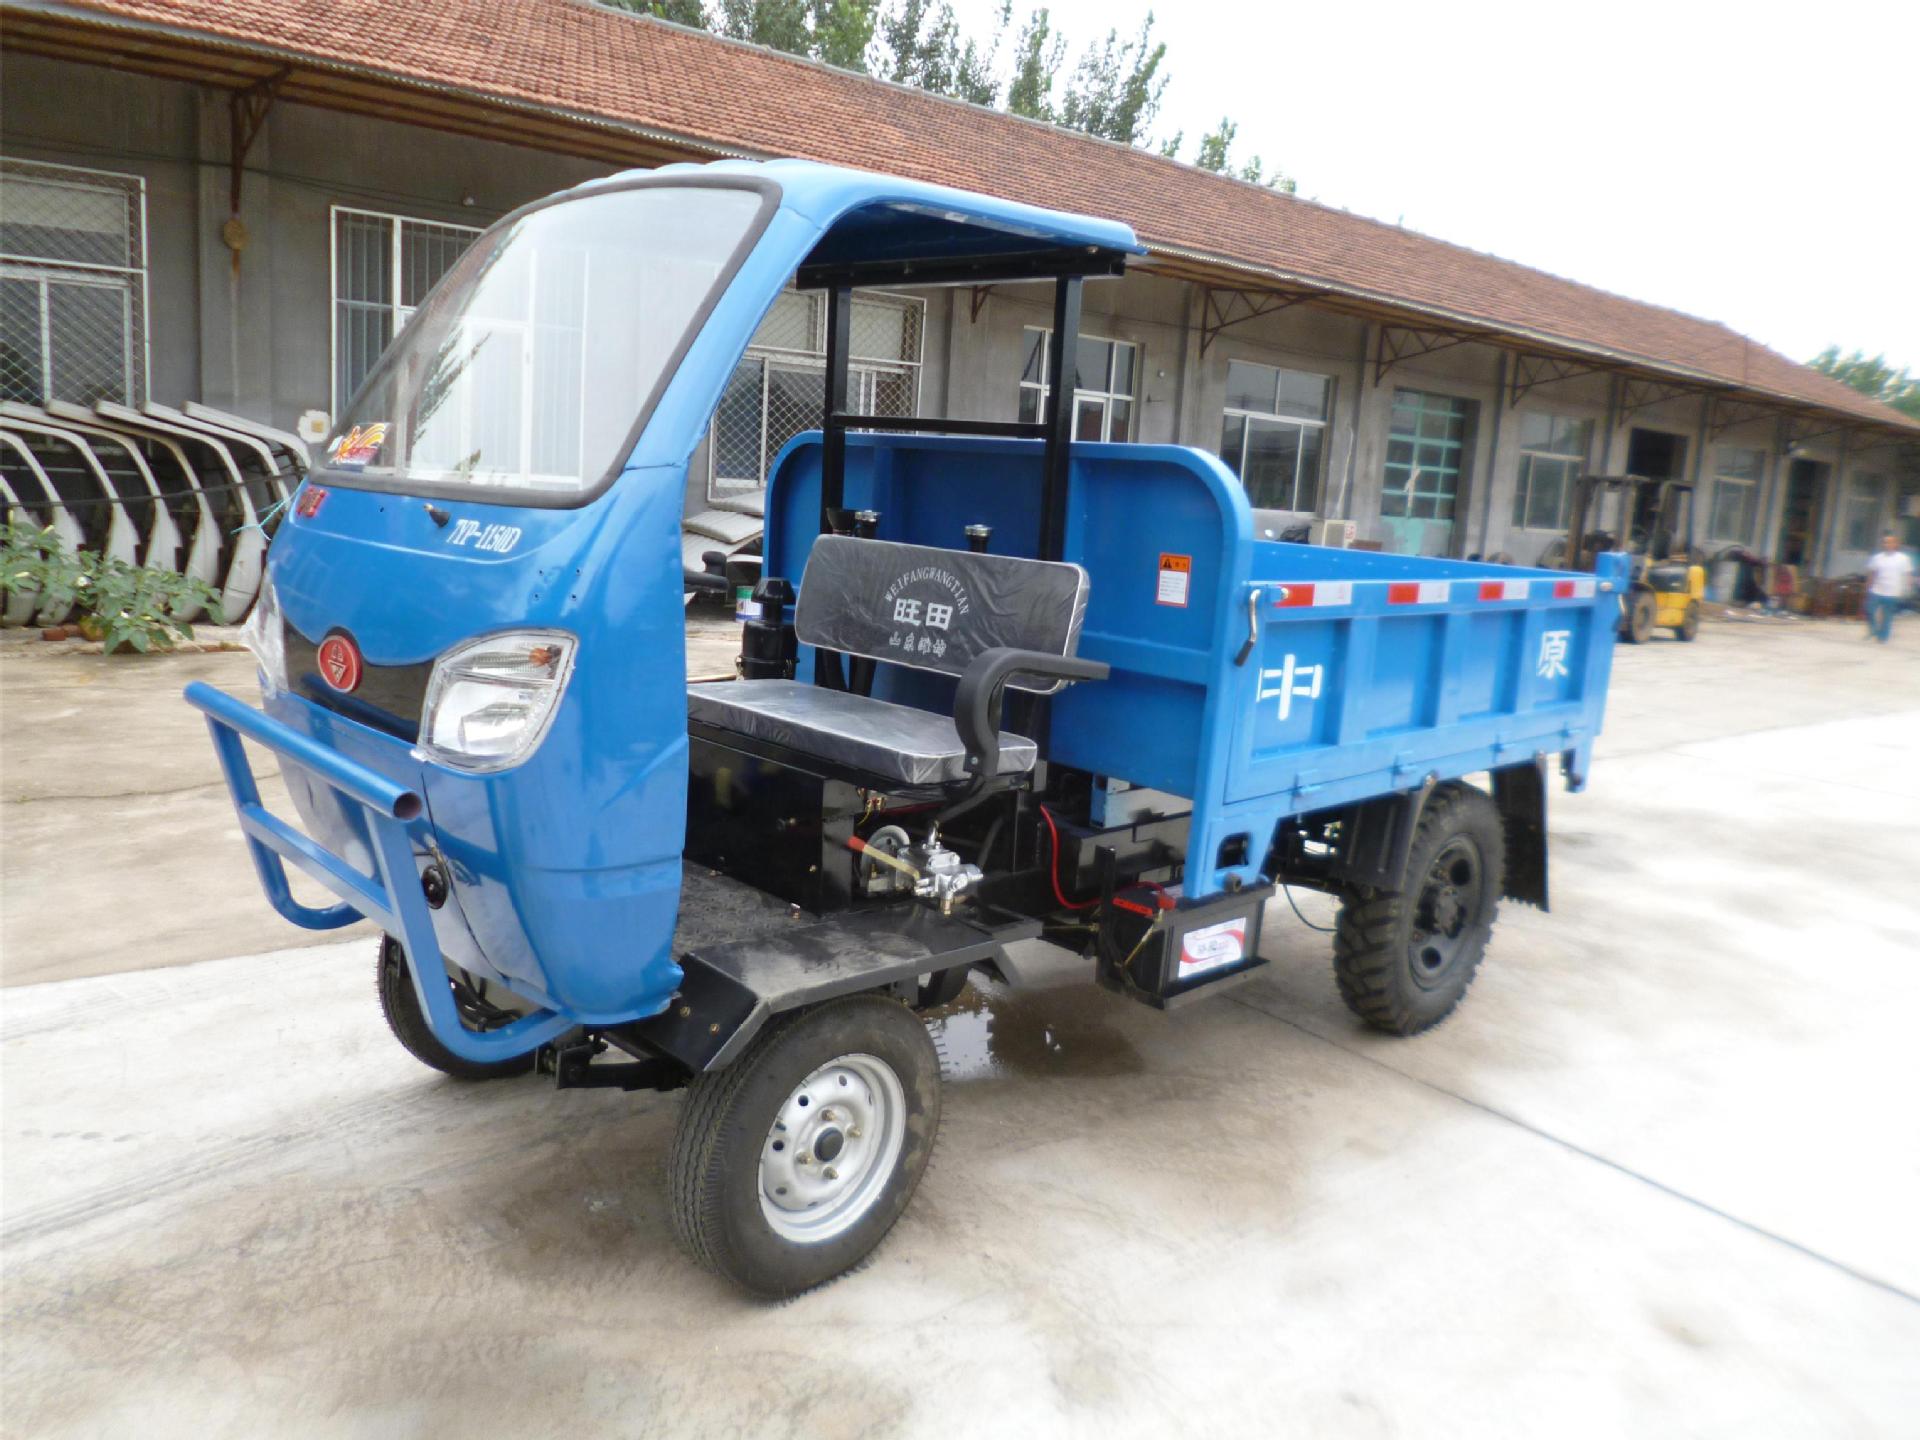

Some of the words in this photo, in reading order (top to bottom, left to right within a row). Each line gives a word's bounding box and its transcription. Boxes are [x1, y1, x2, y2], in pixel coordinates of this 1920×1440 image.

[893, 598, 953, 631] 旺田
[1255, 653, 1323, 721] 中
[1536, 629, 1571, 680] 原
